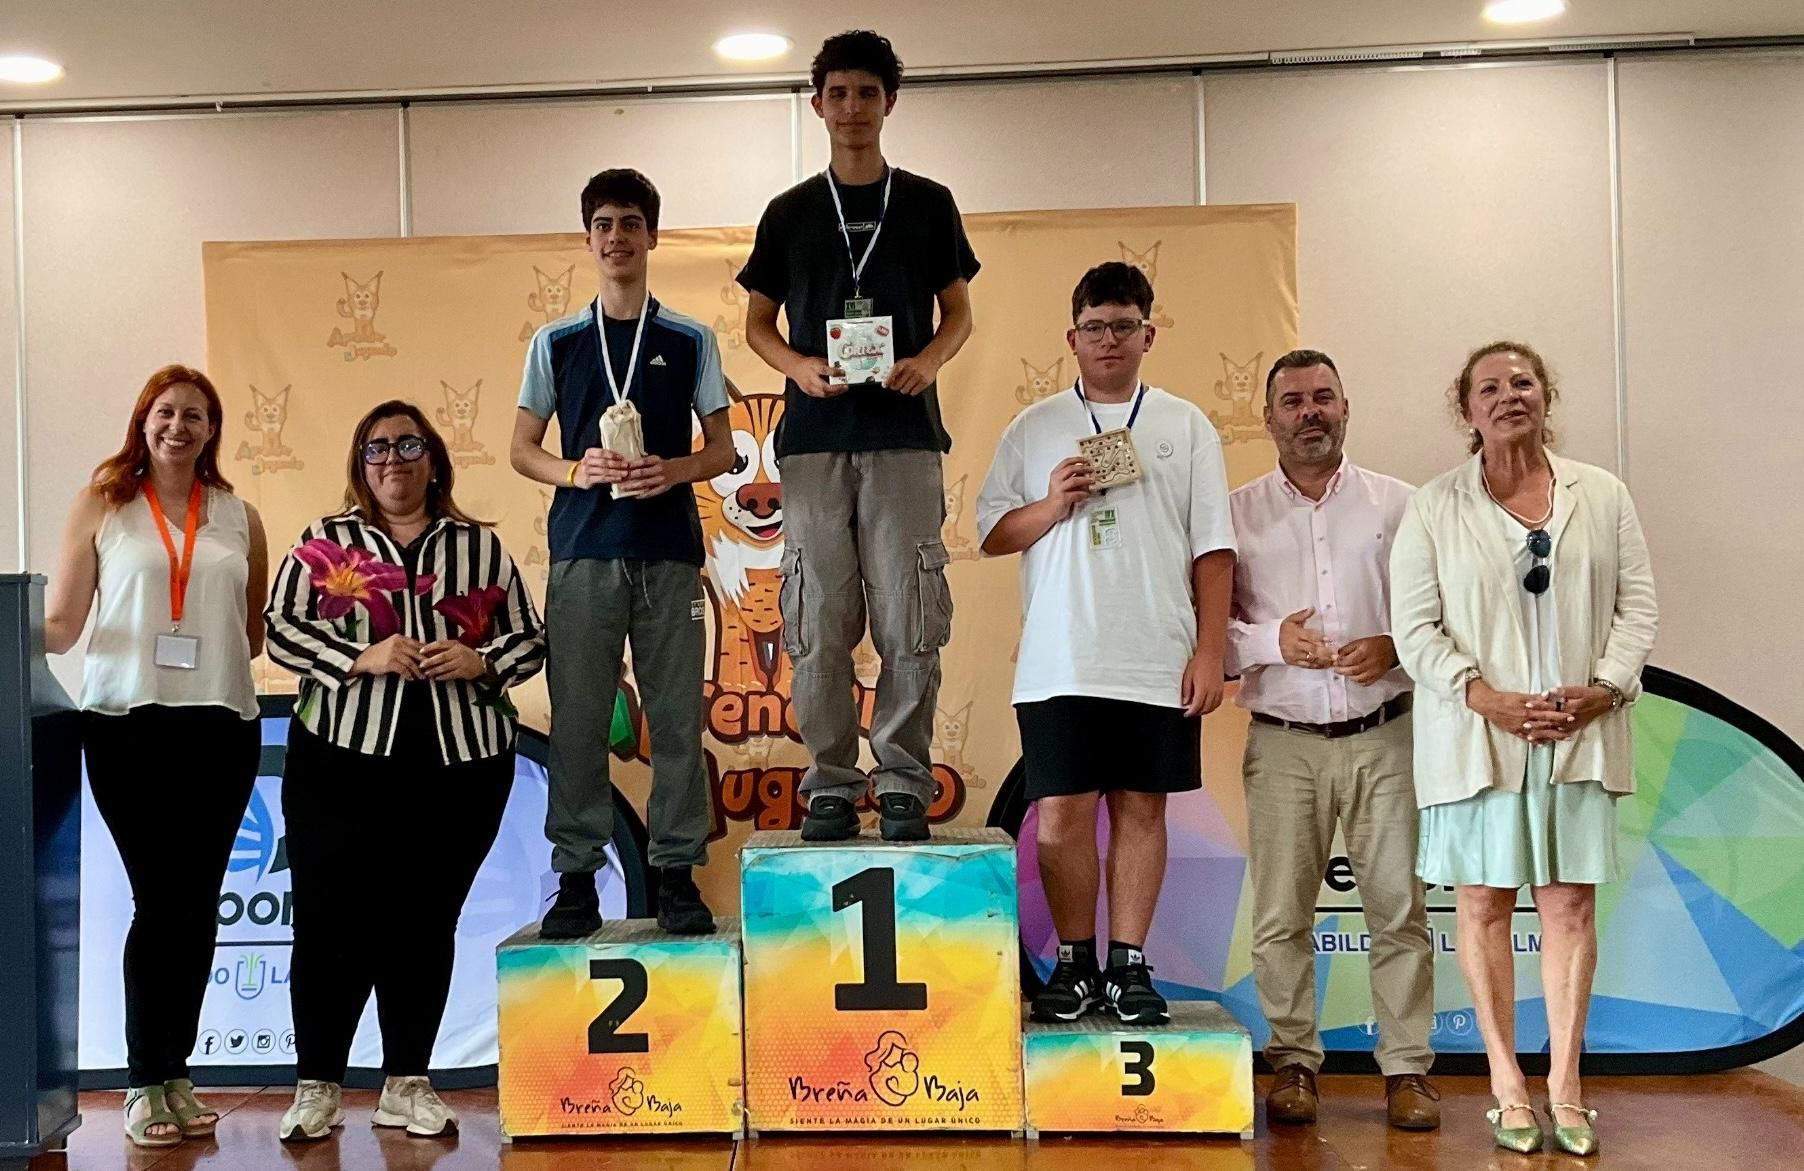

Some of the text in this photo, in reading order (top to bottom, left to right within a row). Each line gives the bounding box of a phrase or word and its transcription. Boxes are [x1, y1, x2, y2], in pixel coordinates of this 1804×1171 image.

[831, 867, 927, 1011] 1
[588, 959, 649, 1054] 2
[1120, 1041, 1155, 1096] 3
[560, 1095, 683, 1117] Breña Baja
[788, 1075, 980, 1111] Breña Baja
[789, 1117, 825, 1125] SIENTE
[829, 1117, 841, 1125] LA
[880, 1117, 893, 1125] DE
[898, 1116, 910, 1124] UN
[915, 1116, 946, 1124] LUGAR
